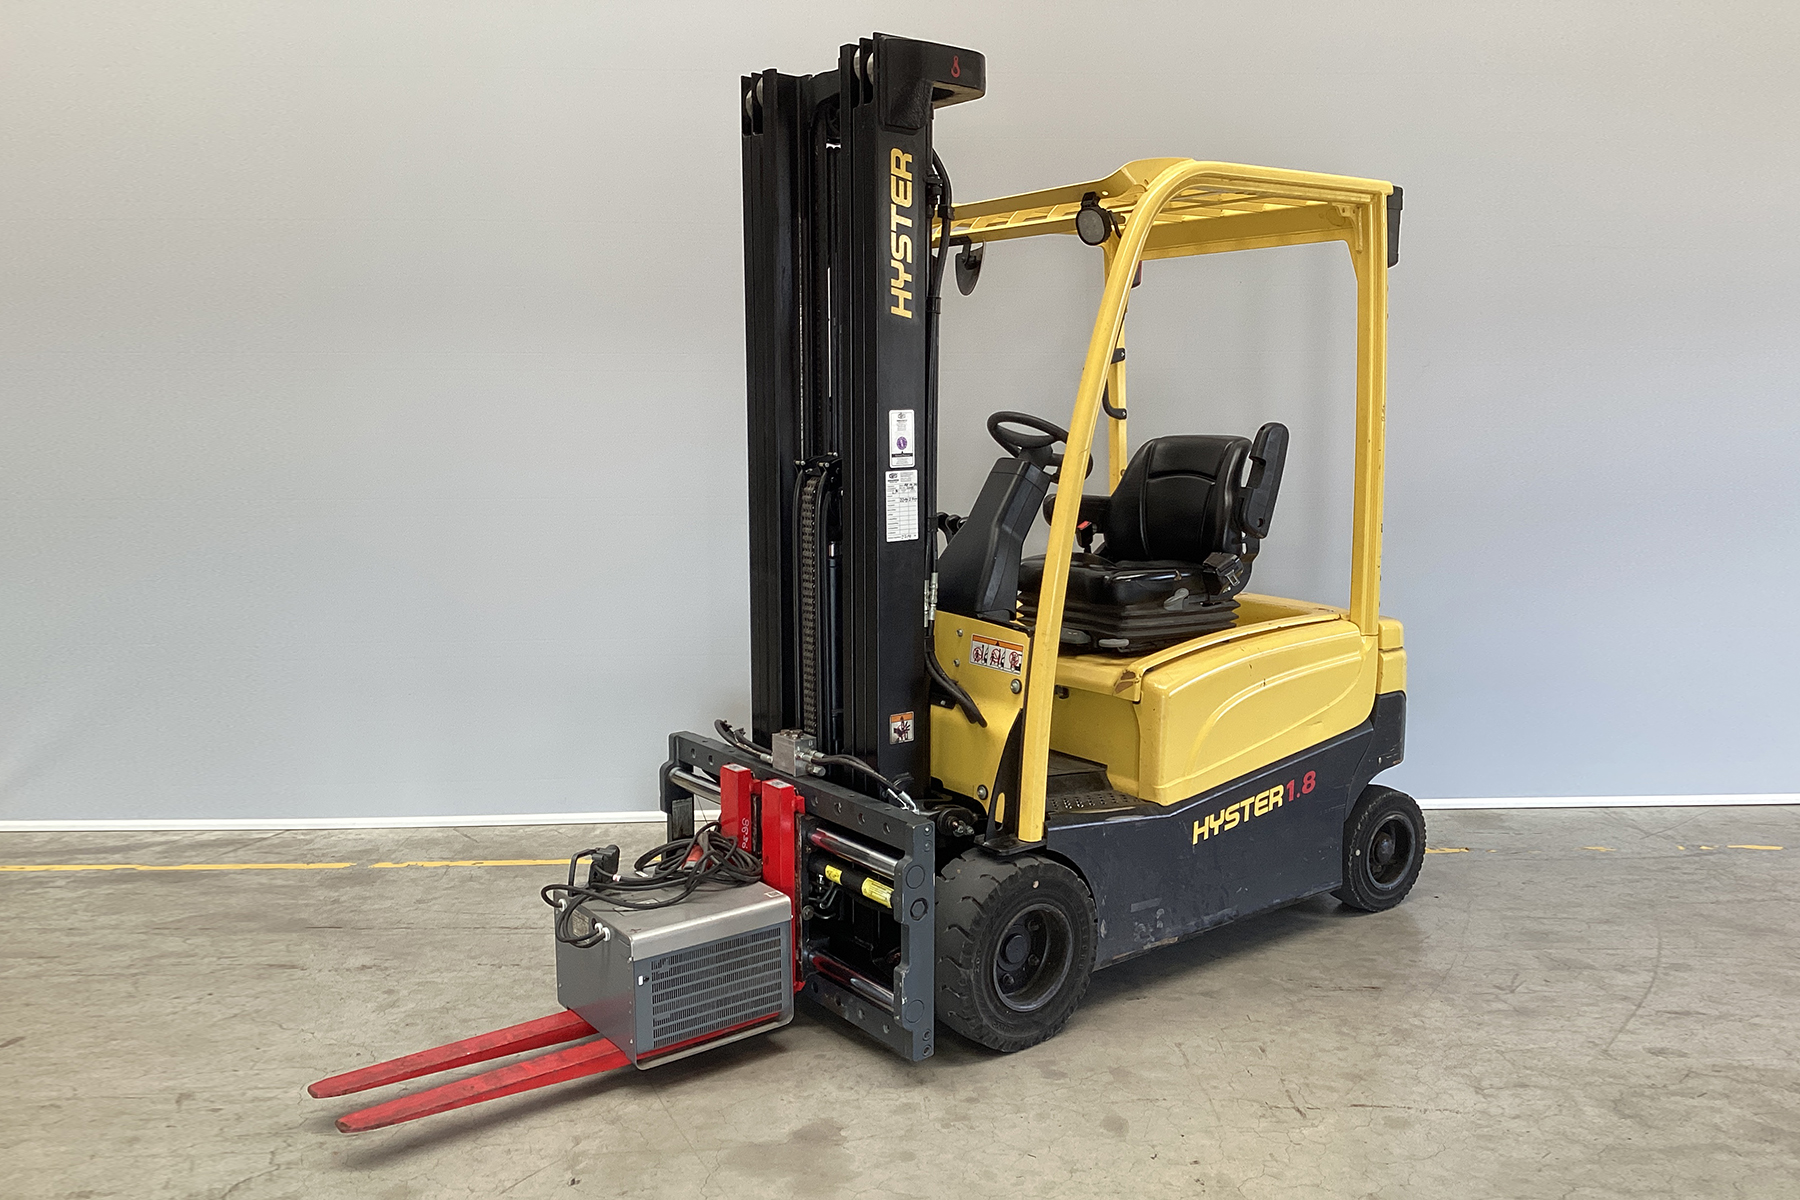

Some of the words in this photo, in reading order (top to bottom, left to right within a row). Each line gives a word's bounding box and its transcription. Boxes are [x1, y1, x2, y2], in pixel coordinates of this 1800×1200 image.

[890, 147, 913, 319] HYSTER
[1192, 784, 1285, 845] HYSTER
[1286, 770, 1317, 802] 1.8
